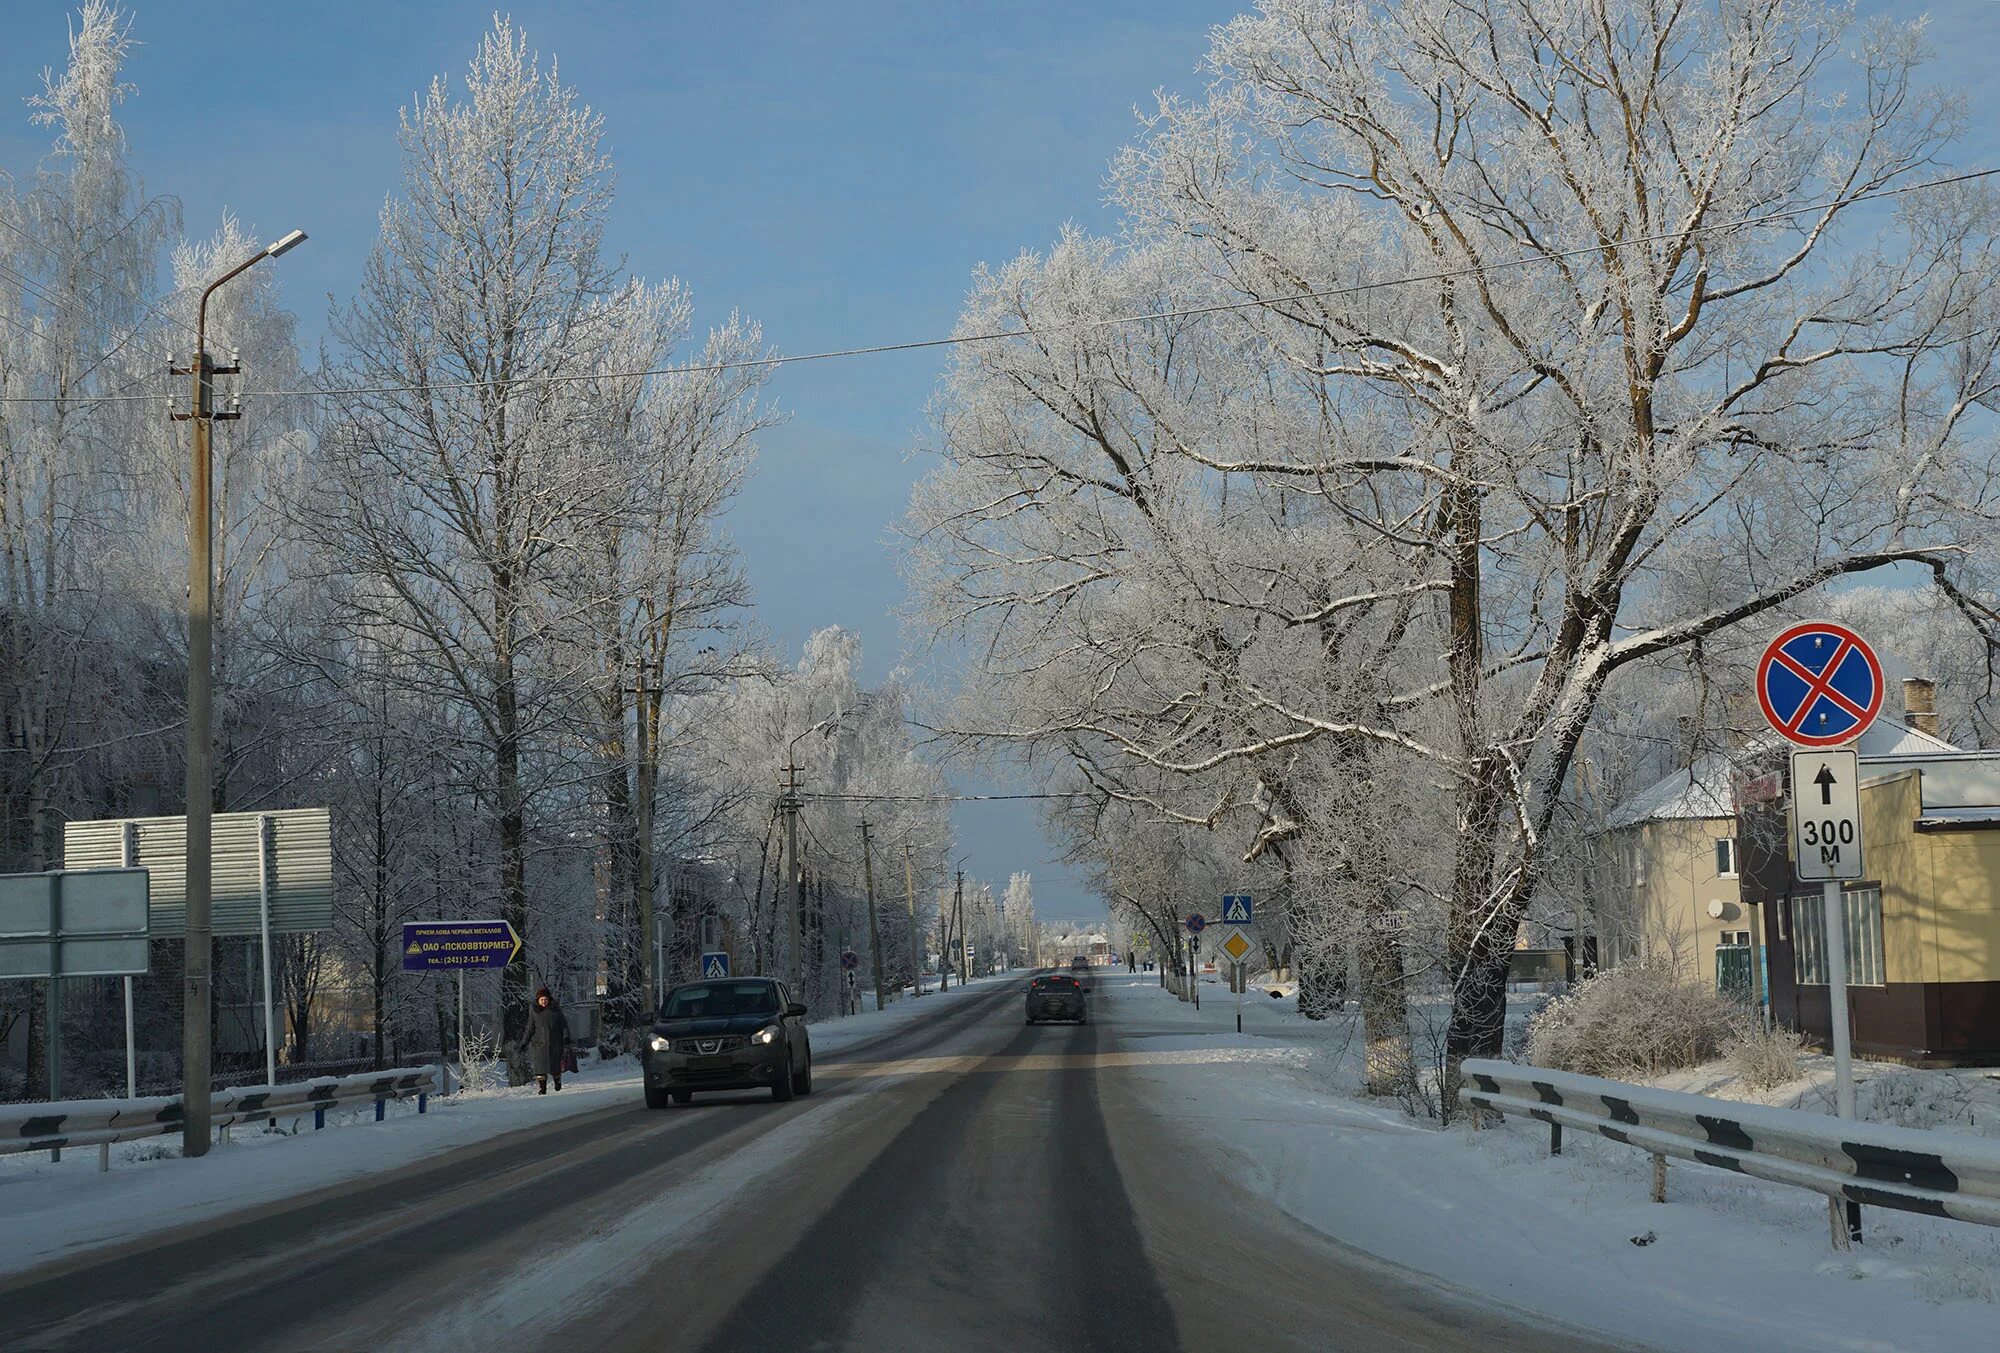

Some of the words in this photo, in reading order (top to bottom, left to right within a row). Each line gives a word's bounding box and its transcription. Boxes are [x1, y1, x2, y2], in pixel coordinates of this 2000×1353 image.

[1803, 819, 1853, 846] 300
[422, 943, 439, 951] ОАО
[441, 941, 514, 951] «ПСКОВВТОРМЕТ»
[444, 956, 463, 965] (241)
